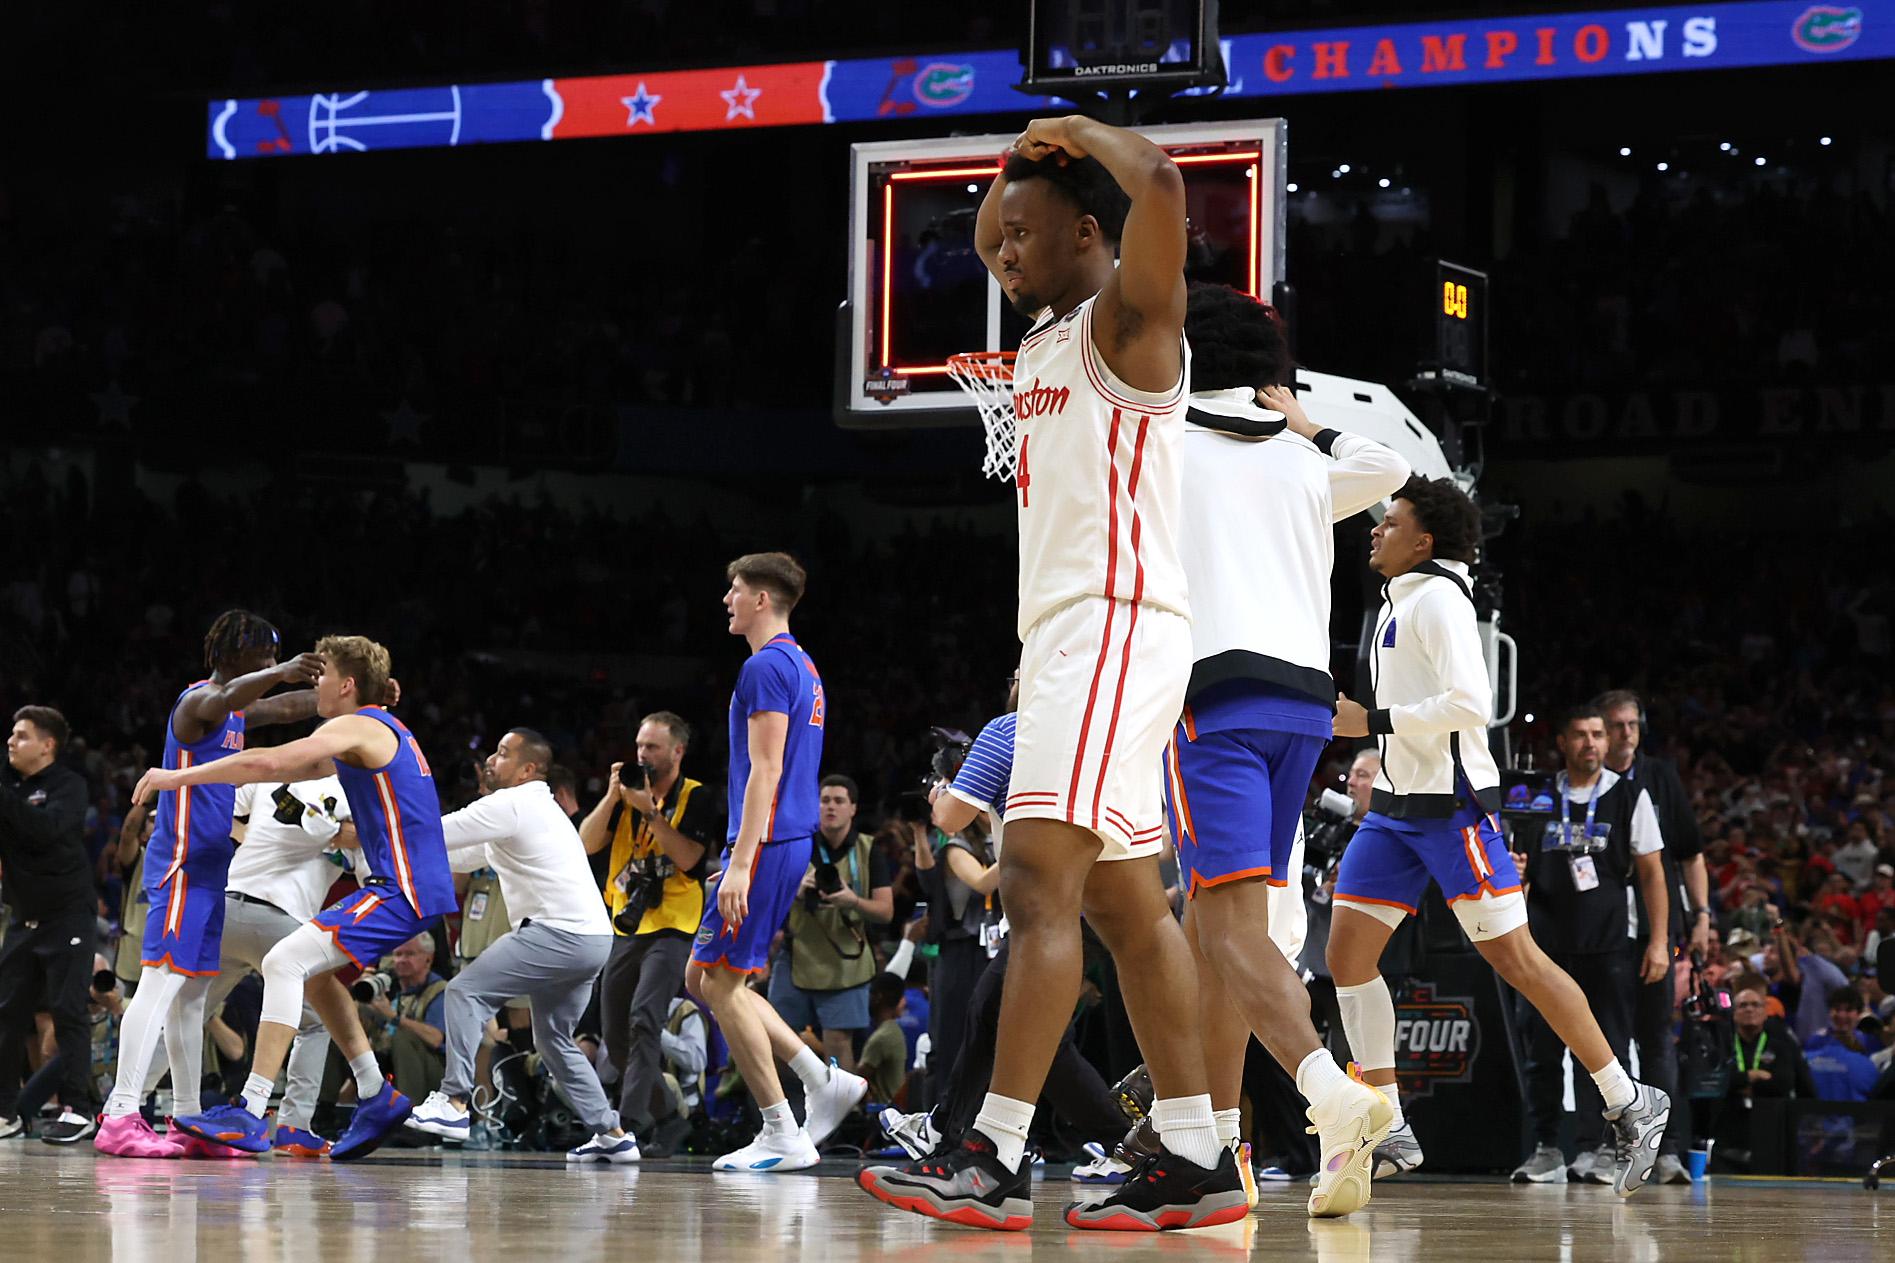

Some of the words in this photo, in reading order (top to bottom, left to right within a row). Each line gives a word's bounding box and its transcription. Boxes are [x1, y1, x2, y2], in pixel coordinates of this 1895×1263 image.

[1074, 63, 1158, 76] DAKTRONICS
[1263, 16, 1718, 82] CHAMPIONS
[1016, 434, 1031, 508] 4
[1394, 1020, 1471, 1052] FOUR
